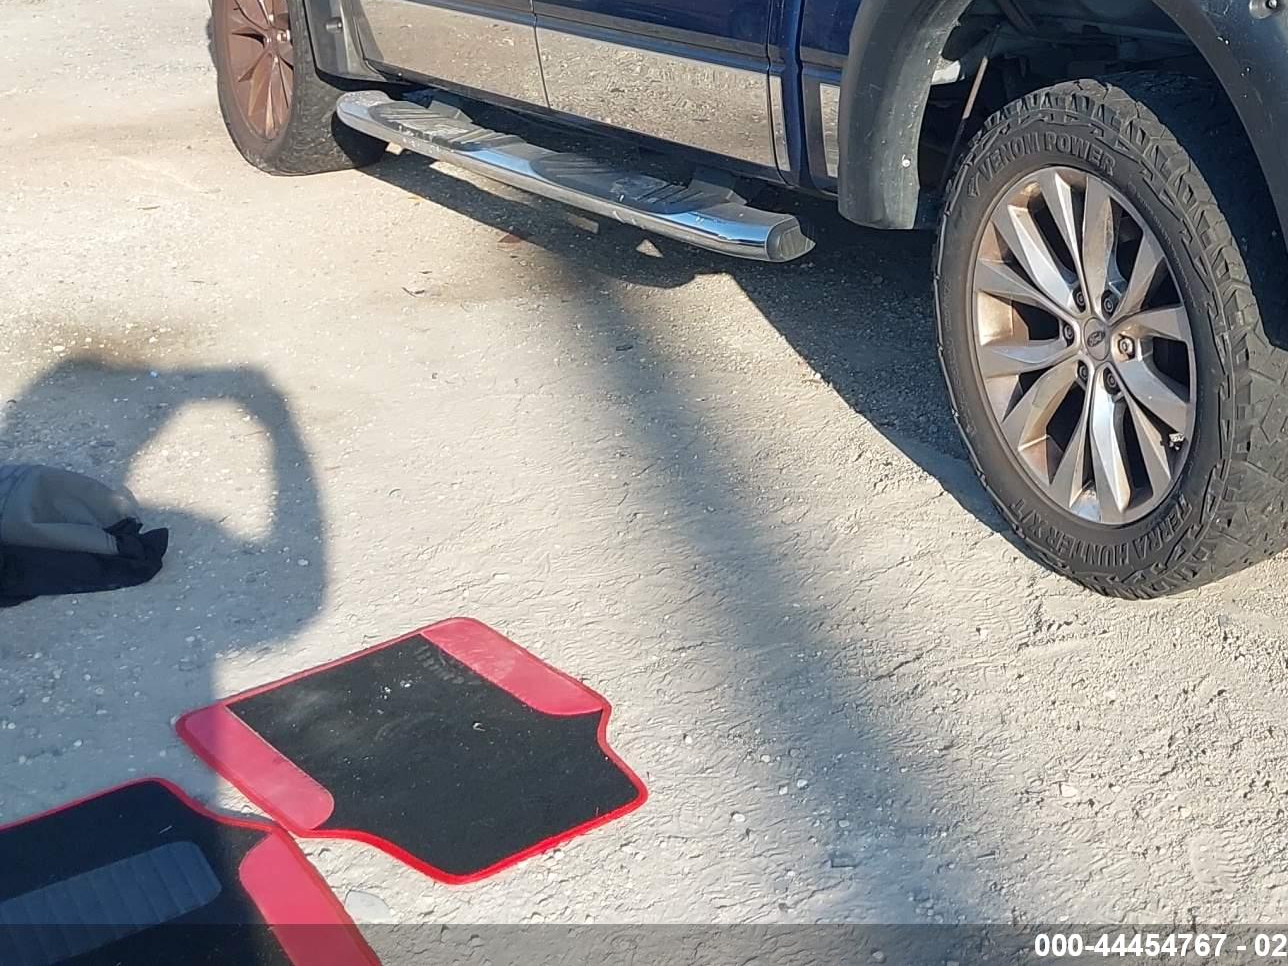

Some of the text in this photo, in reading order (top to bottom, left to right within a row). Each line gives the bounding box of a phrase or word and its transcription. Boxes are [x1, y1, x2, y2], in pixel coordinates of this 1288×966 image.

[977, 131, 1116, 182] VENOM POWER
[1047, 527, 1130, 566] HUNTER
[1133, 494, 1192, 558] TERRA
